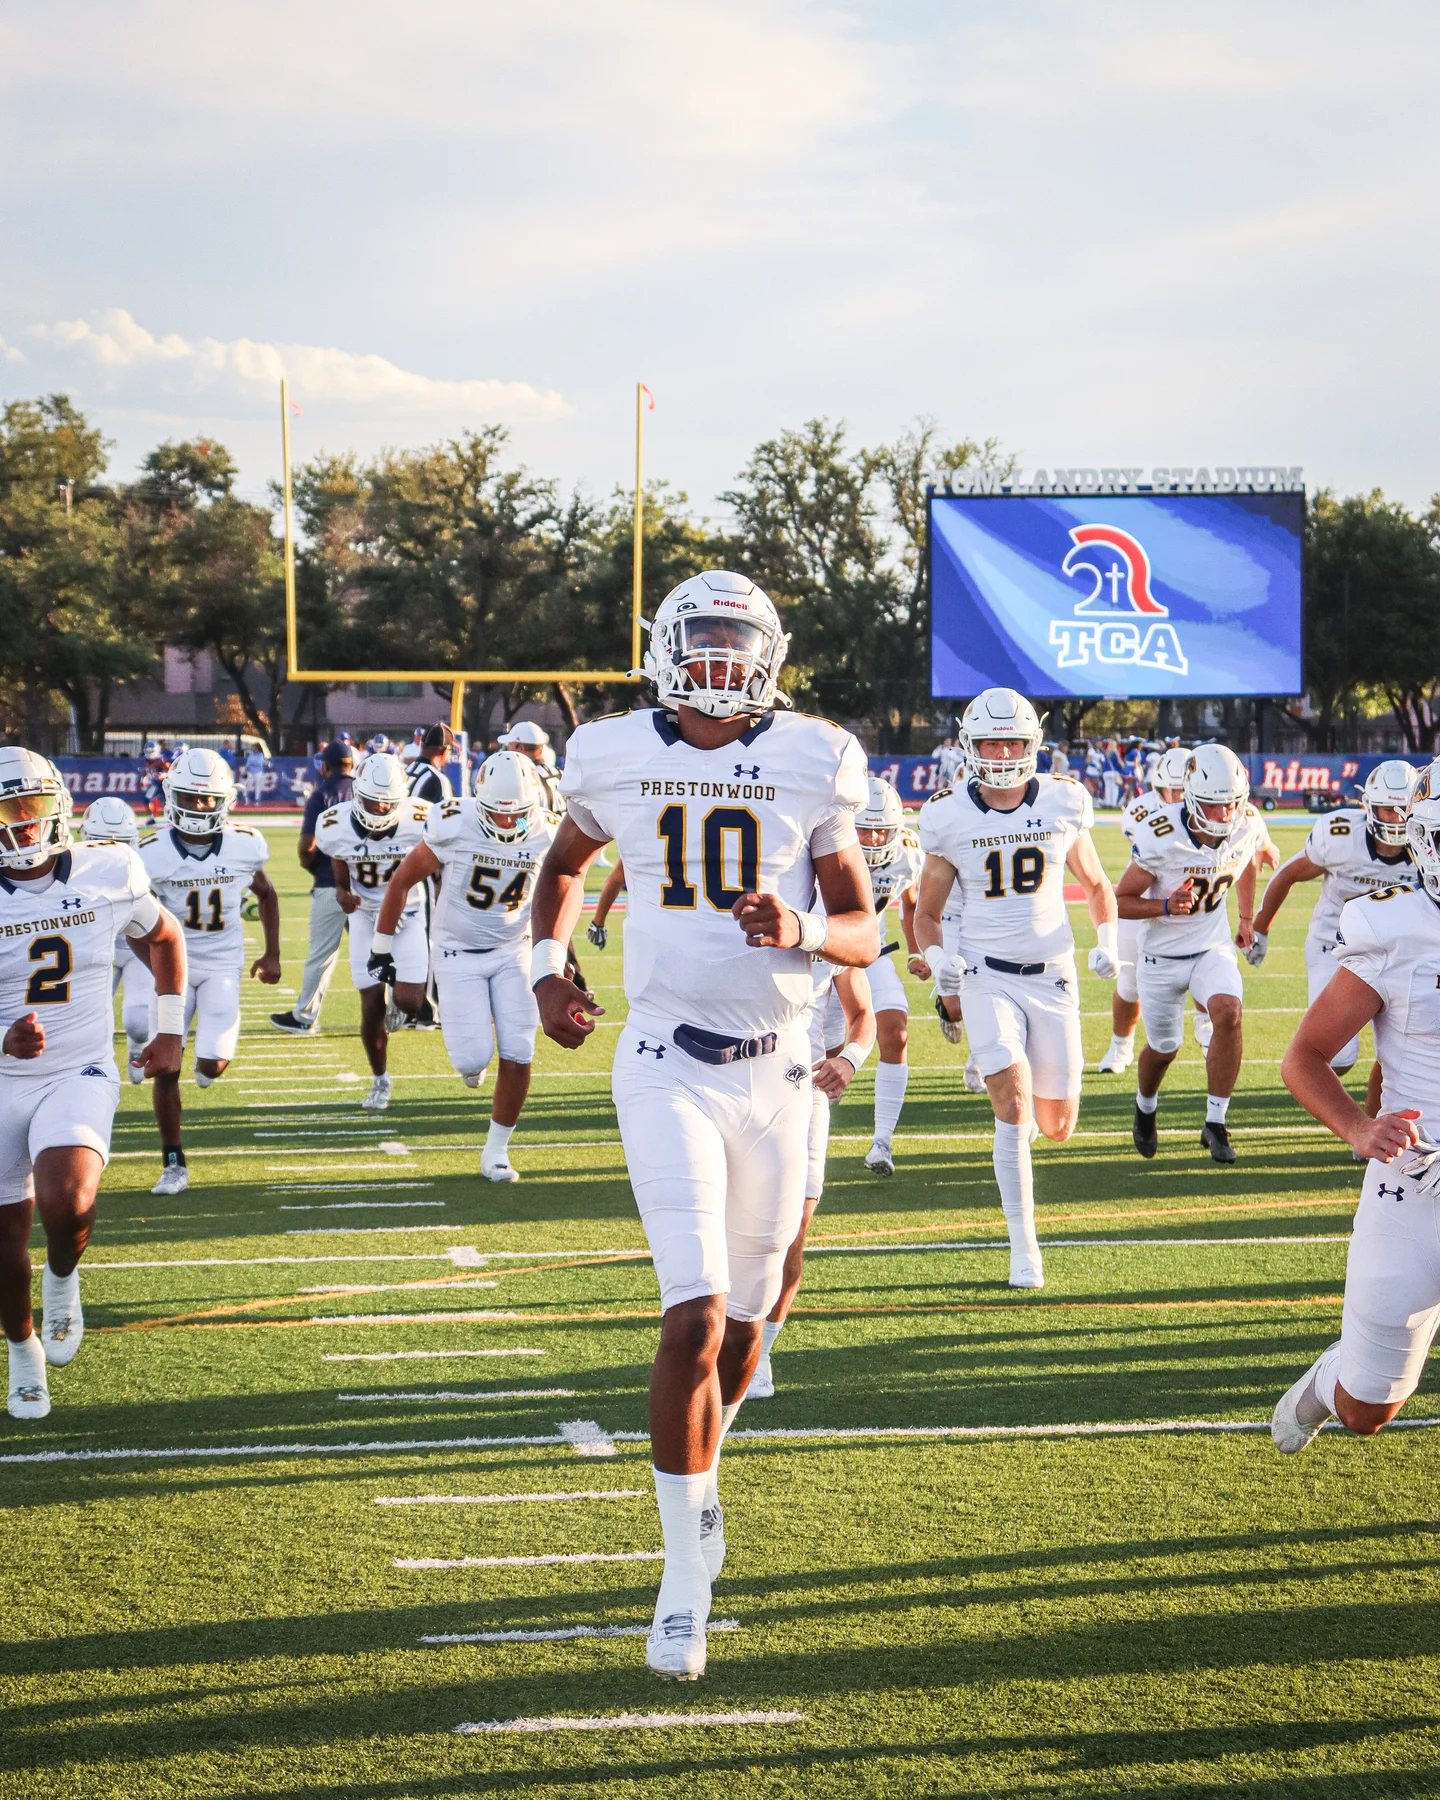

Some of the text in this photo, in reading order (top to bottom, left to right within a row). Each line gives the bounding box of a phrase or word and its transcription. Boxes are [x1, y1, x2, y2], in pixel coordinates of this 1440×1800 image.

[930, 466, 1303, 494] TOM LANDRY STADIUM
[713, 599, 748, 610] Riddell
[1049, 619, 1188, 676] TCA
[63, 771, 146, 793] nam
[641, 781, 776, 801] PRESTONWOOD
[1147, 815, 1175, 838] 80
[973, 831, 1052, 848] PRESTONWOOD
[472, 853, 536, 870] PRESTONWOOD
[657, 803, 761, 912] 10
[171, 875, 234, 887] PRESTONWOOD
[984, 845, 1046, 898] 18
[466, 864, 529, 912] 54
[184, 887, 225, 932] 11
[25, 934, 74, 1005] 2
